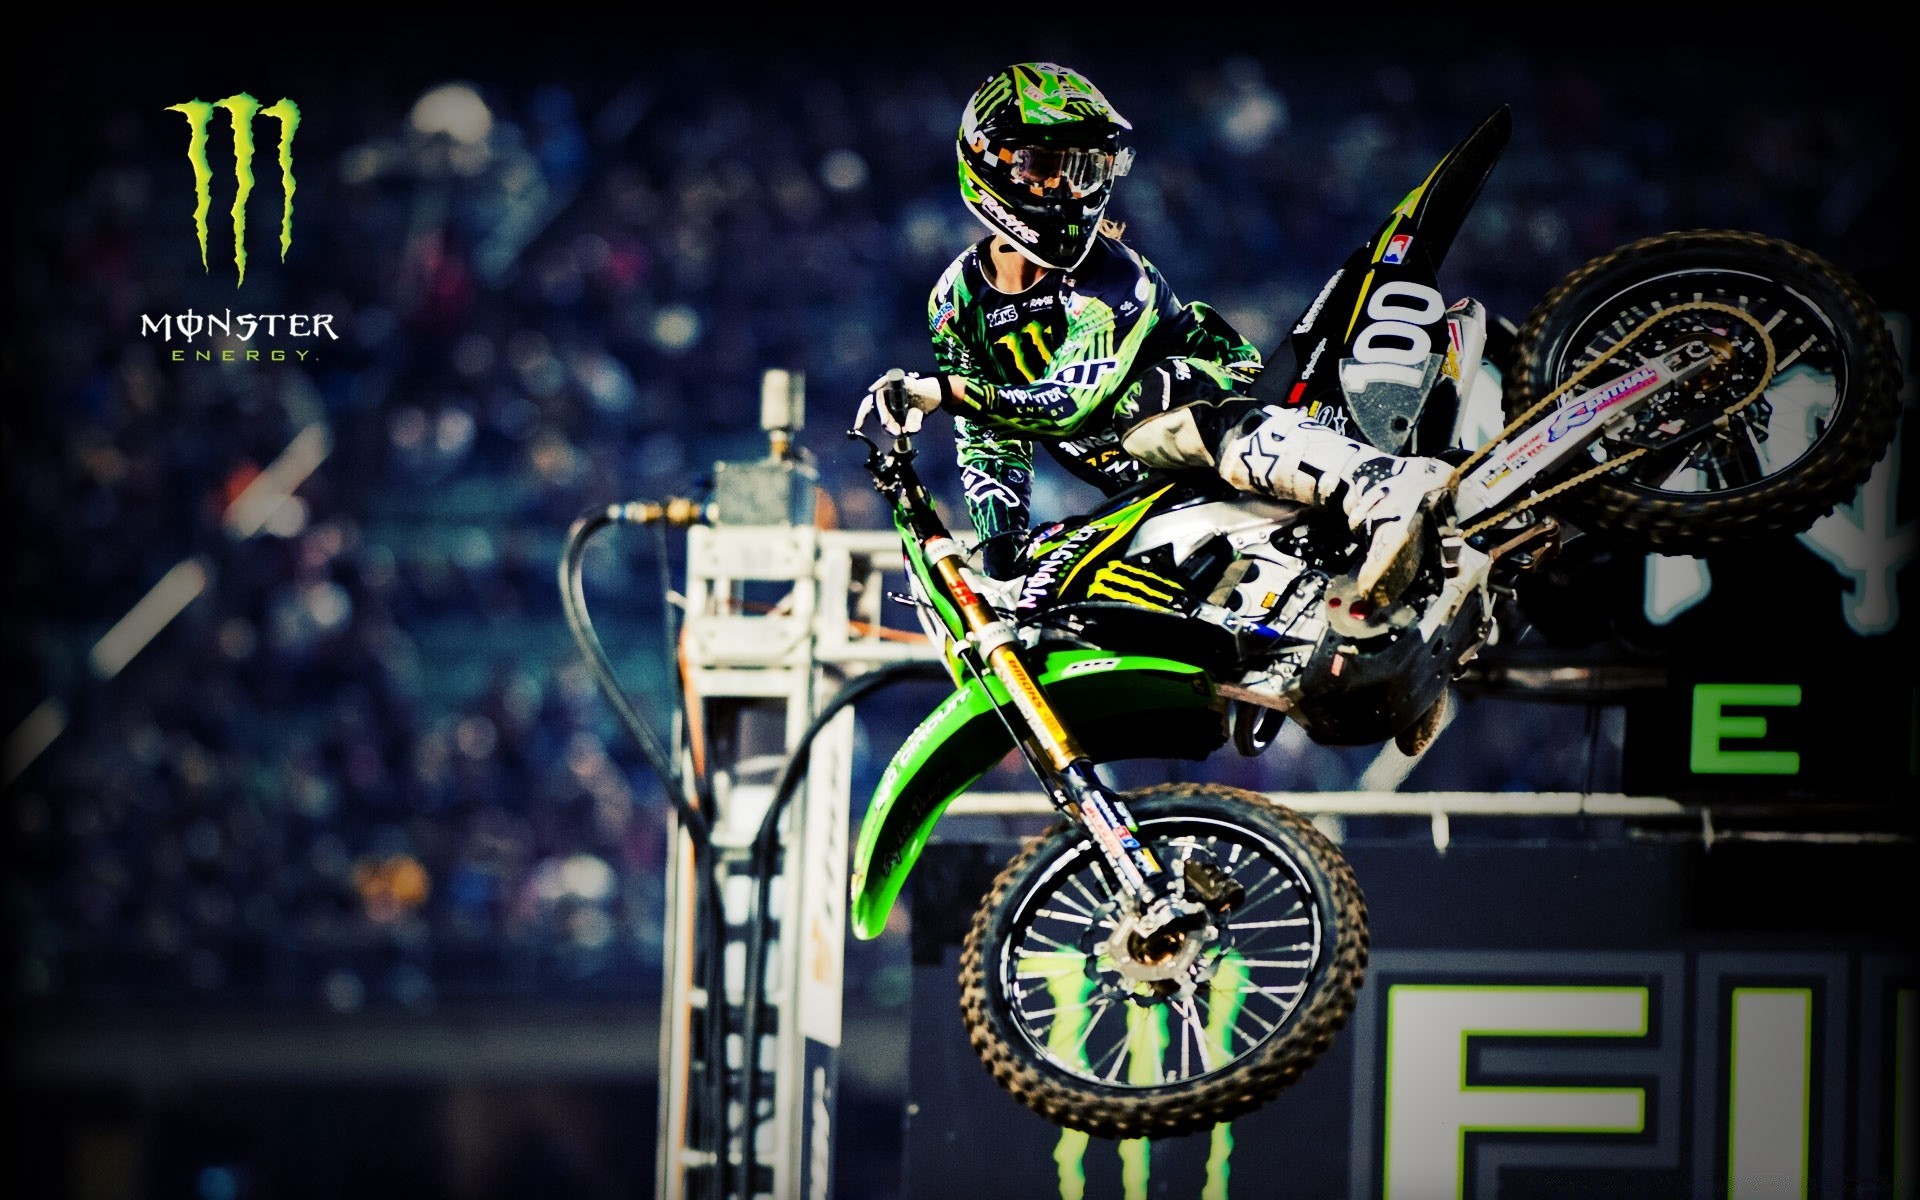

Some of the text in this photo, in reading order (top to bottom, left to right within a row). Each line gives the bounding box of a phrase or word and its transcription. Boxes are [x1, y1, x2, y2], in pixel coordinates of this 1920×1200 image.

[986, 304, 1018, 328] VANS
[1344, 280, 1446, 393] 100
[1015, 405, 1065, 417] ENEGY
[1383, 984, 1920, 1200] FI
